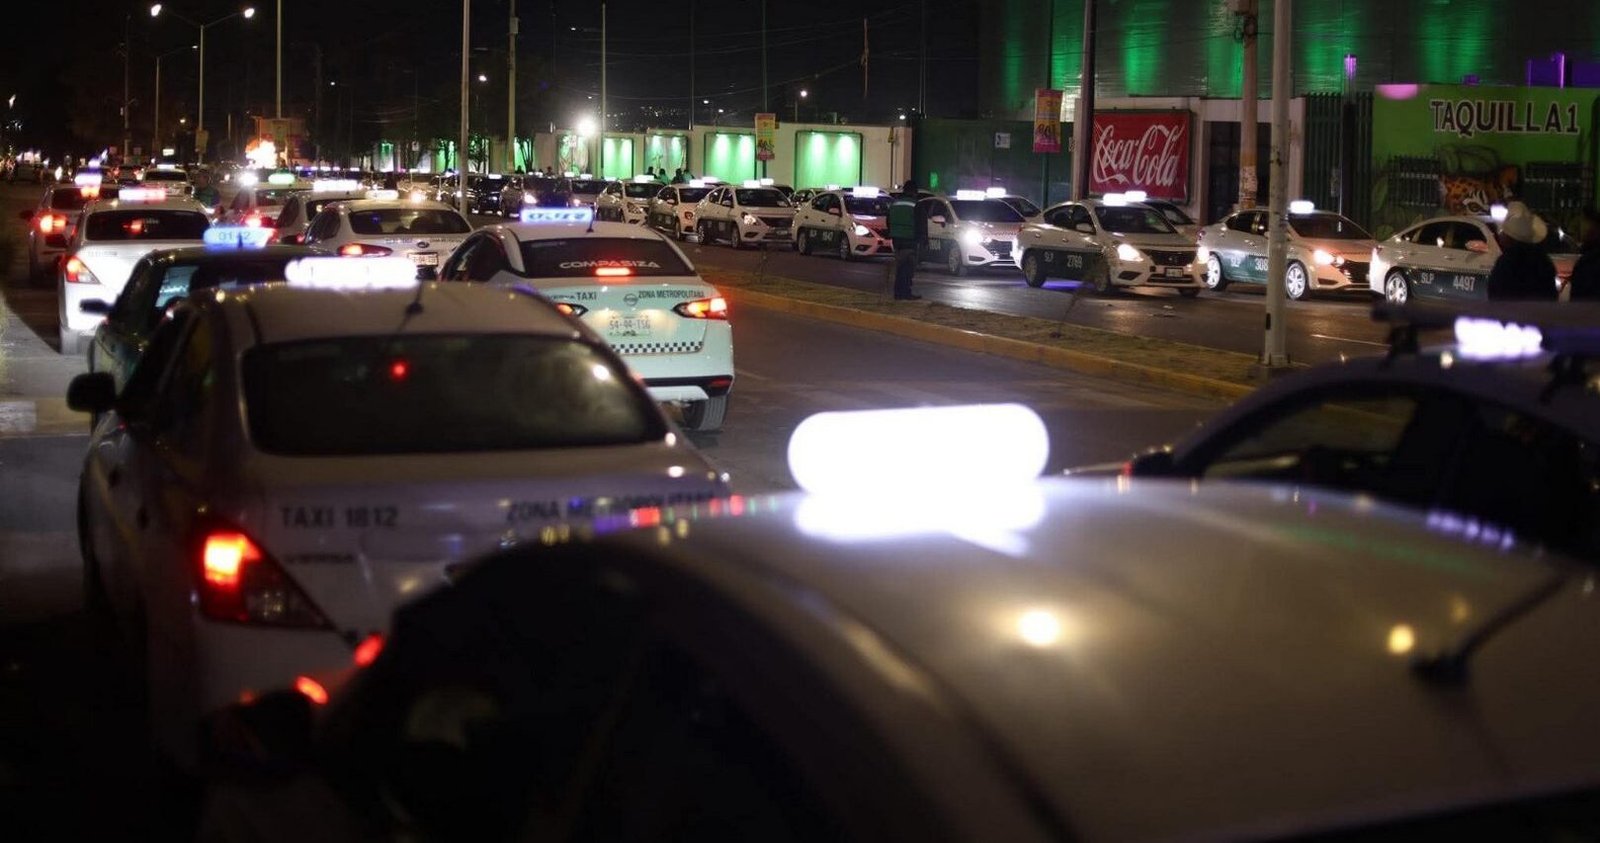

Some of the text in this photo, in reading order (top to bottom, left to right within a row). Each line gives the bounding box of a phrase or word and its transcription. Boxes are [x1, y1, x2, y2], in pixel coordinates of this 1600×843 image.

[1430, 100, 1562, 136] TAQUILLA
[559, 260, 661, 269] COMPASIZA
[1421, 272, 1476, 292] SLP 4497
[576, 292, 598, 301] TAXI
[637, 290, 705, 299] ZONA METROPOLITANA
[282, 506, 335, 528] TAXI
